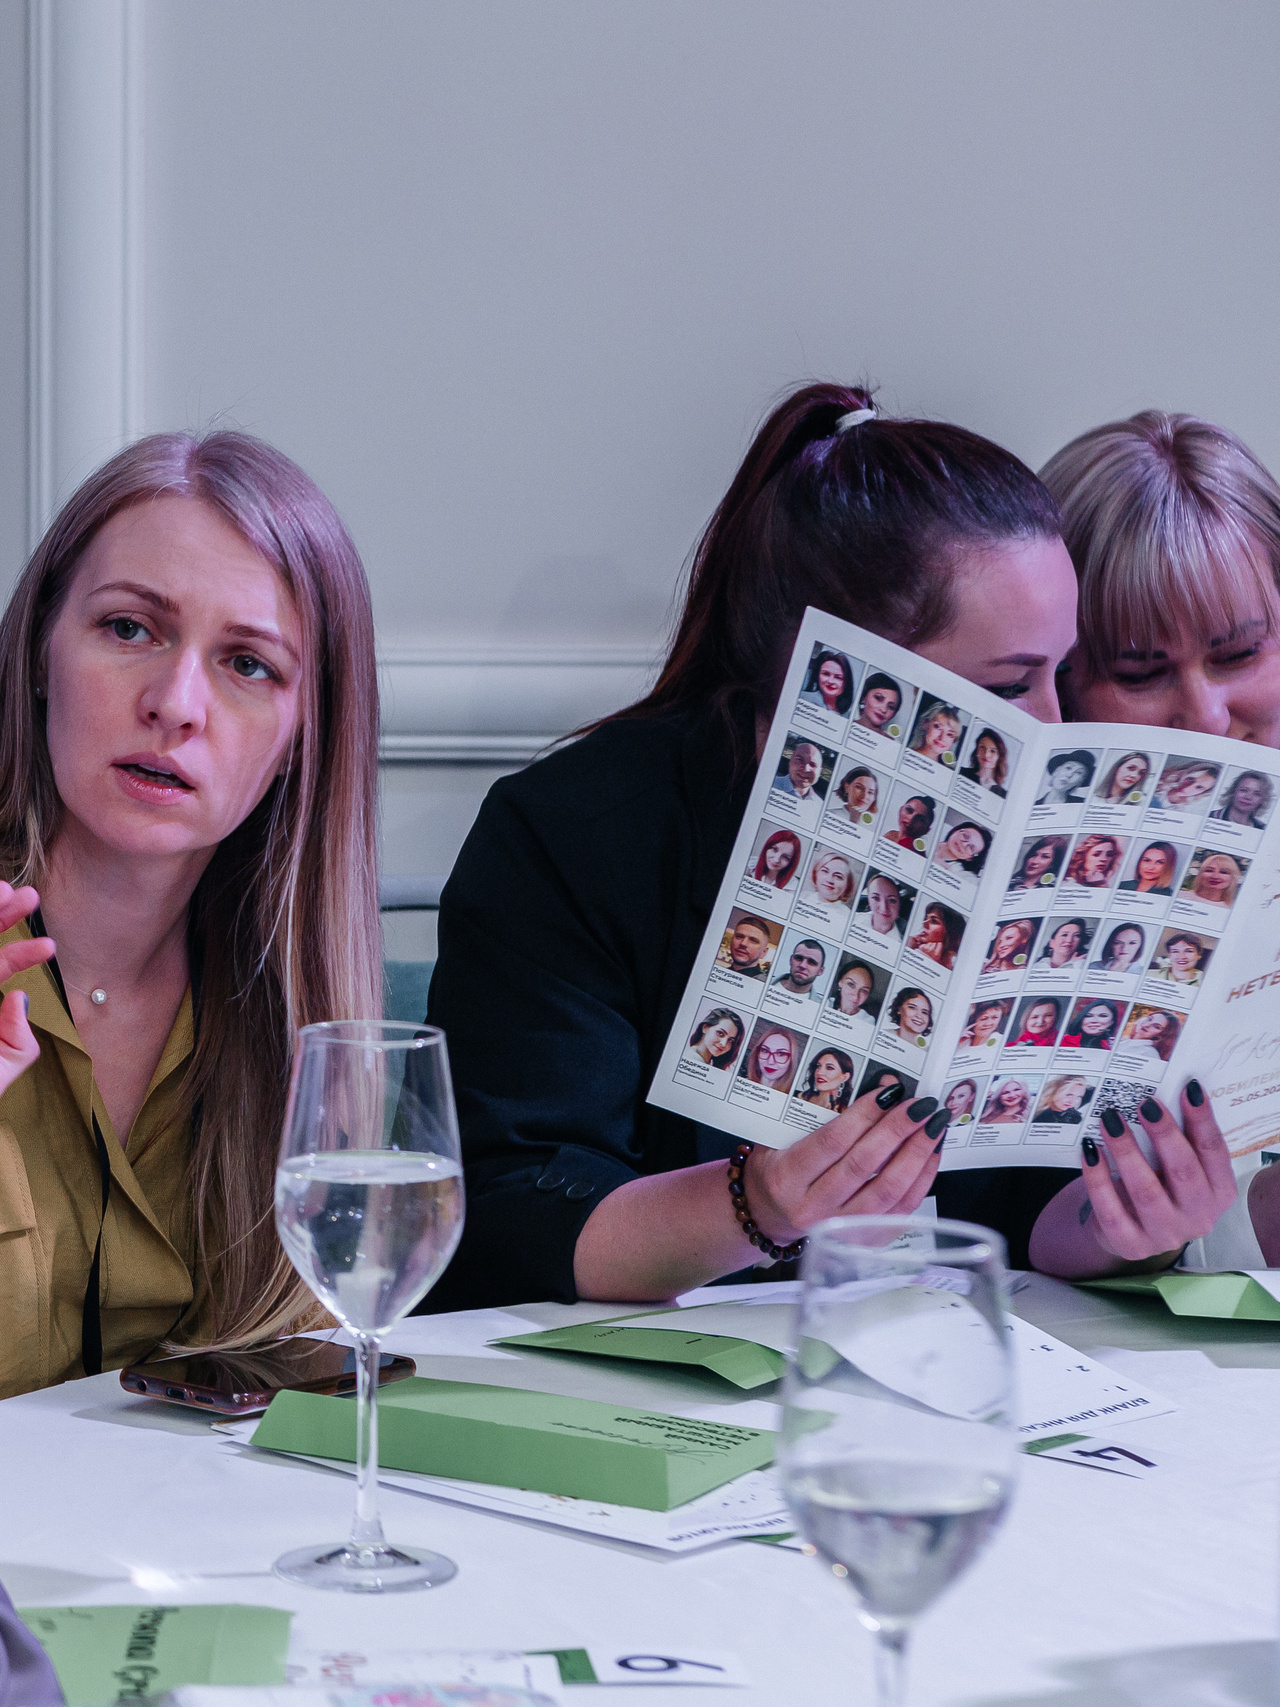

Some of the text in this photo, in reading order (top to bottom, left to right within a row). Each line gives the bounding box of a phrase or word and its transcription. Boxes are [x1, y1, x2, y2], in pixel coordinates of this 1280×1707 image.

[711, 973, 744, 989] Станислав
[713, 966, 743, 982] Потураев
[766, 994, 790, 1006] Иванов
[768, 987, 804, 1005] Александр
[681, 1058, 710, 1072] Надежда
[736, 1078, 771, 1095] Маргарита
[1096, 1397, 1151, 1415] БЛАНК
[1065, 1409, 1100, 1423] ДЛЯ
[663, 1433, 731, 1450] САМЫЙ
[1070, 1446, 1159, 1469] 4
[617, 1654, 725, 1672] 6
